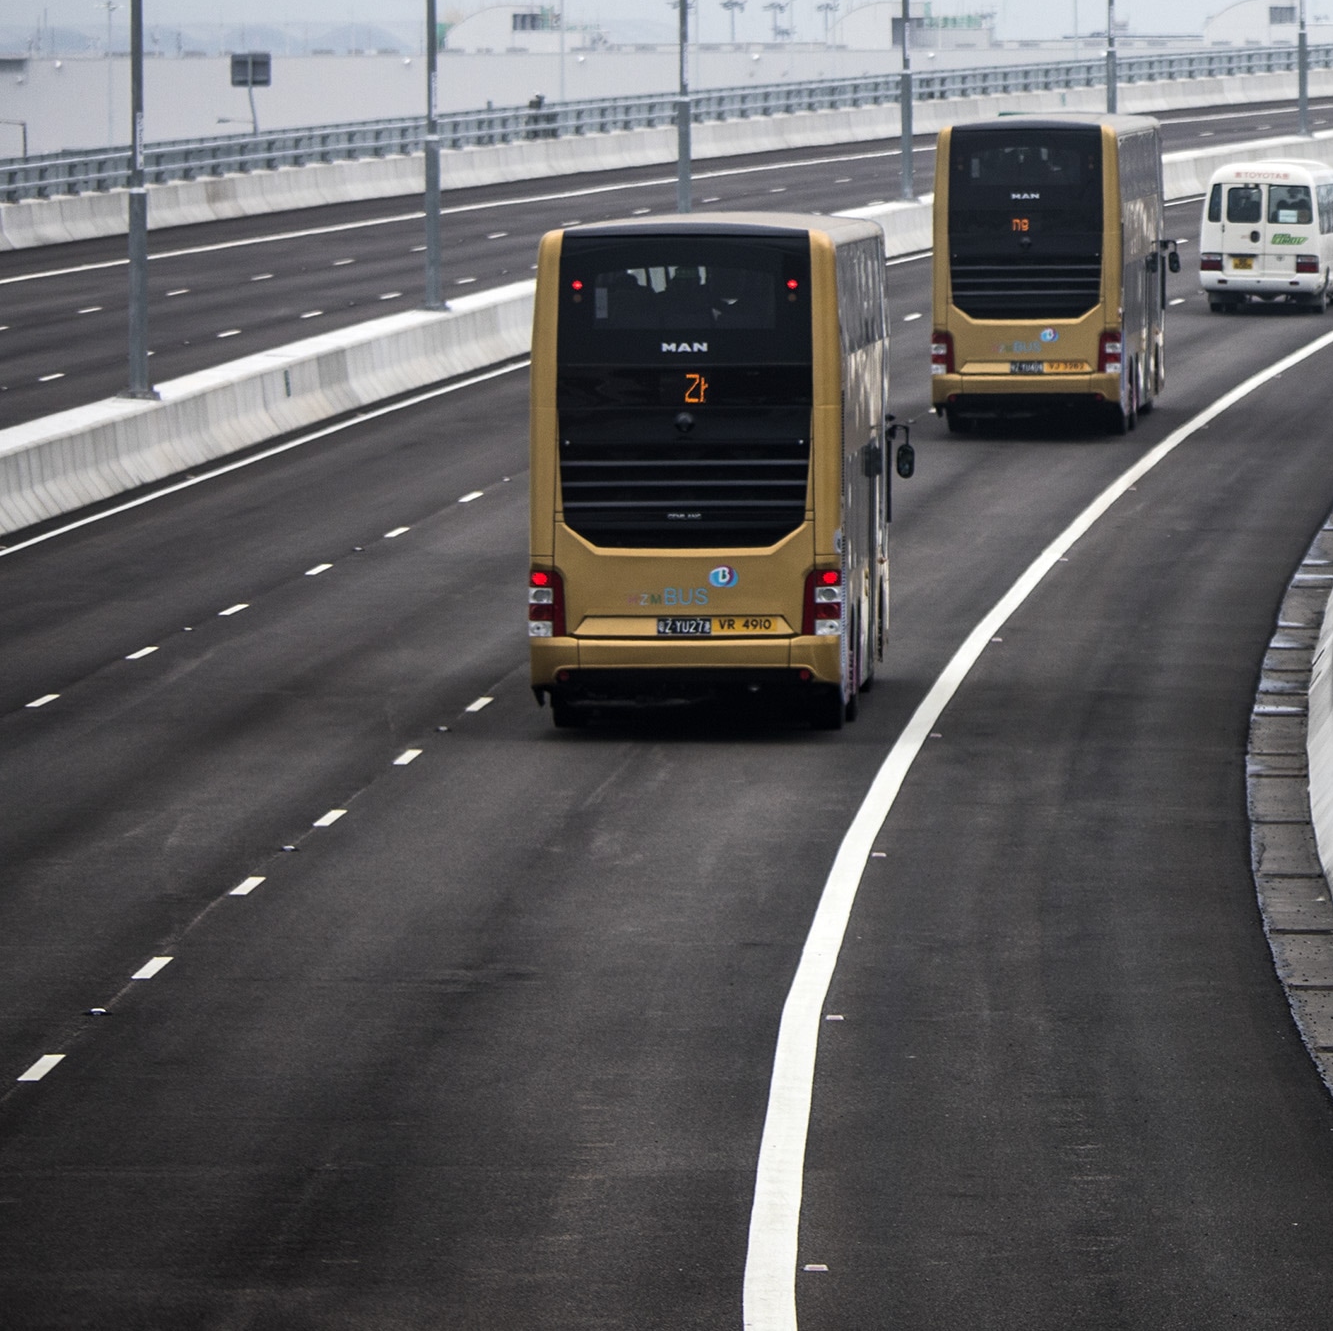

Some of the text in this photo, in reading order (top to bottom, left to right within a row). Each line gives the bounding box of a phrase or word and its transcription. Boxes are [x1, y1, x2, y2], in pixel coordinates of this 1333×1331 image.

[1244, 172, 1283, 180] TOYOTA
[661, 342, 708, 353] MAN
[719, 619, 772, 630] VR 4910
